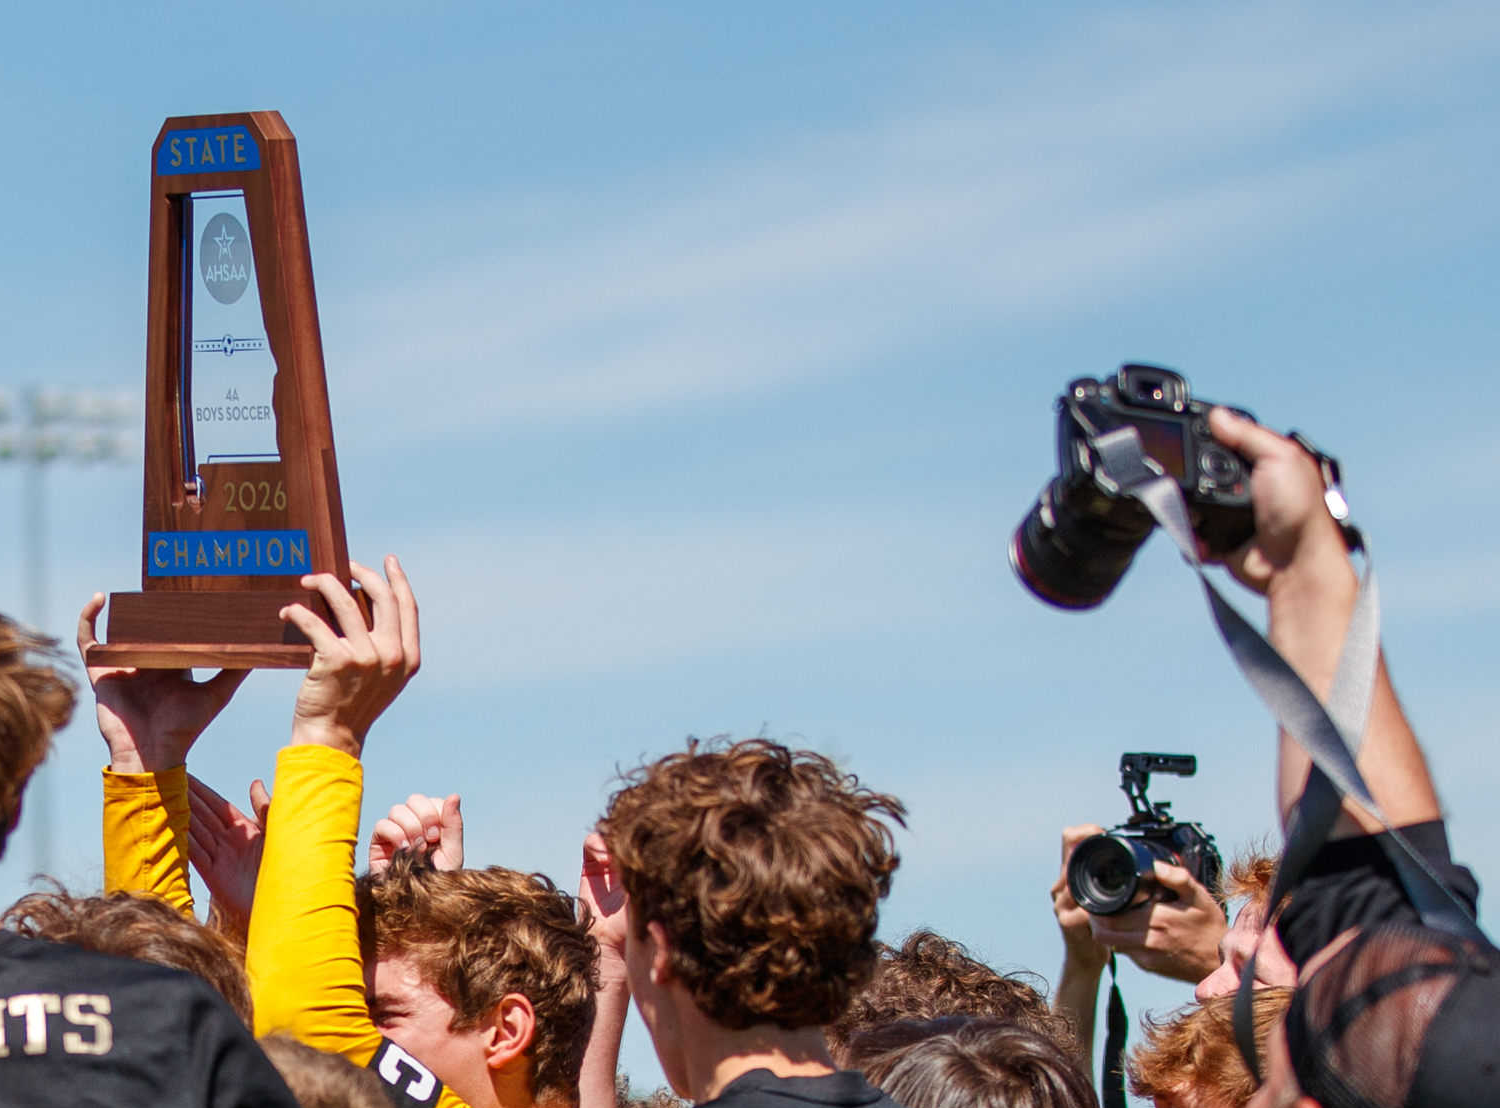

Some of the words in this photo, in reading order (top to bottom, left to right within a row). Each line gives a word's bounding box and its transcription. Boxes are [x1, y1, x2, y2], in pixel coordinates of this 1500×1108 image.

[169, 132, 247, 168] STATE
[205, 263, 248, 283] AHSAA
[225, 387, 240, 402] 4A
[196, 406, 224, 422] BOYS
[226, 405, 271, 421] SOCCER
[223, 481, 288, 512] 2026
[153, 536, 306, 570] CHAMPION
